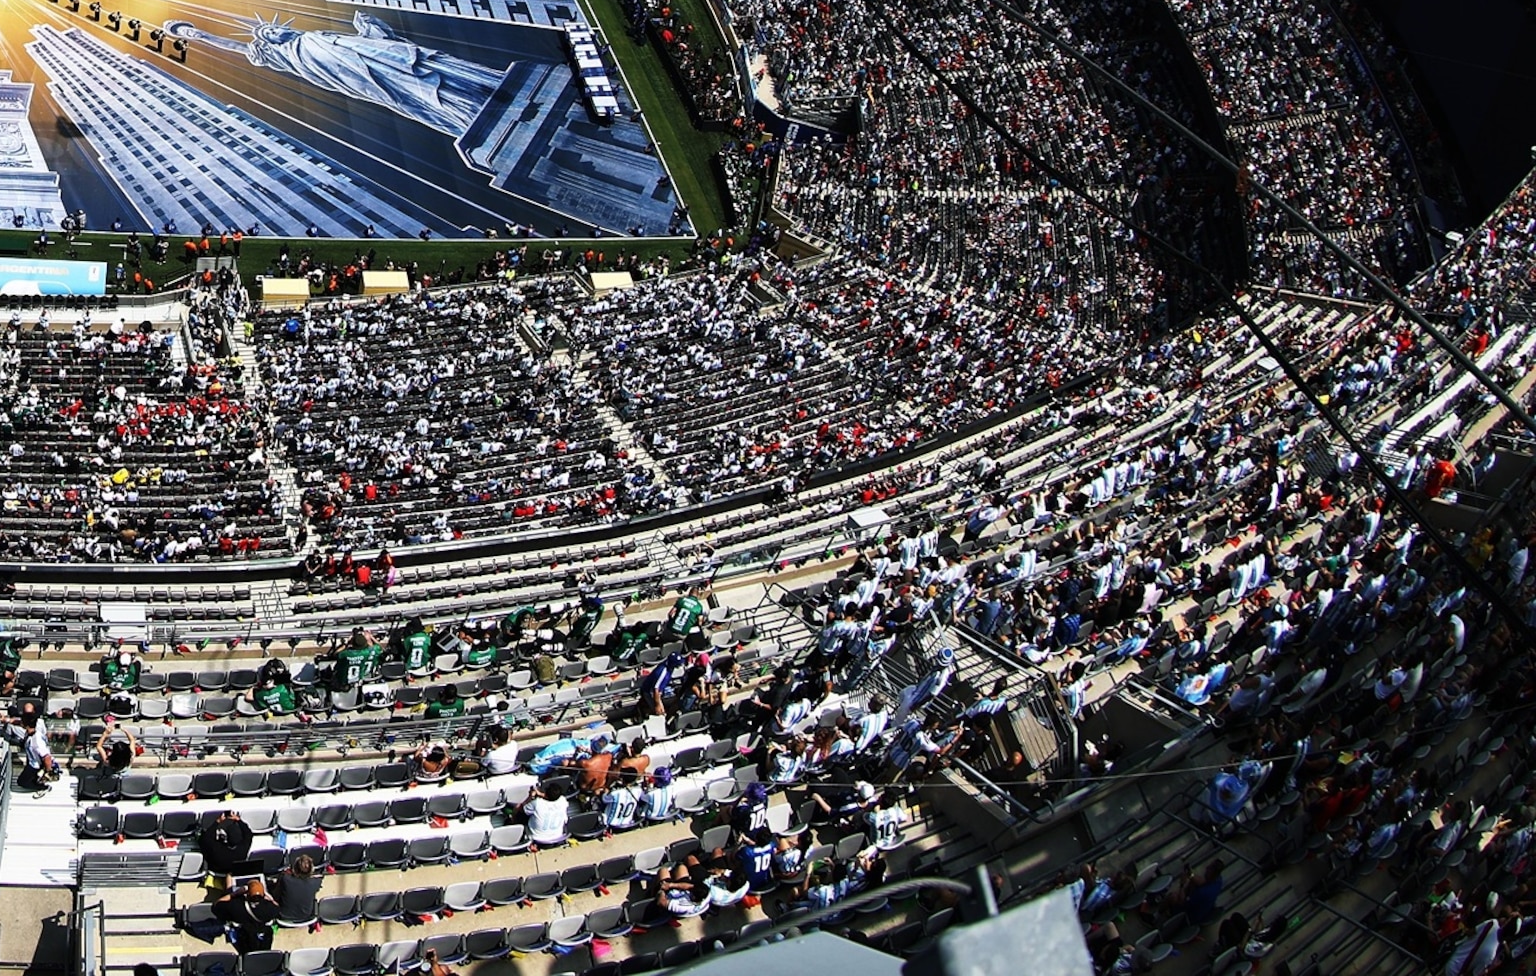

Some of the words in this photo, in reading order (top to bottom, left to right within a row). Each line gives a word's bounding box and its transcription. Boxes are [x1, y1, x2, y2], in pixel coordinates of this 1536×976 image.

[619, 801, 635, 819] 10
[749, 808, 766, 832] 10
[878, 820, 897, 841] 10
[754, 854, 772, 873] 10
